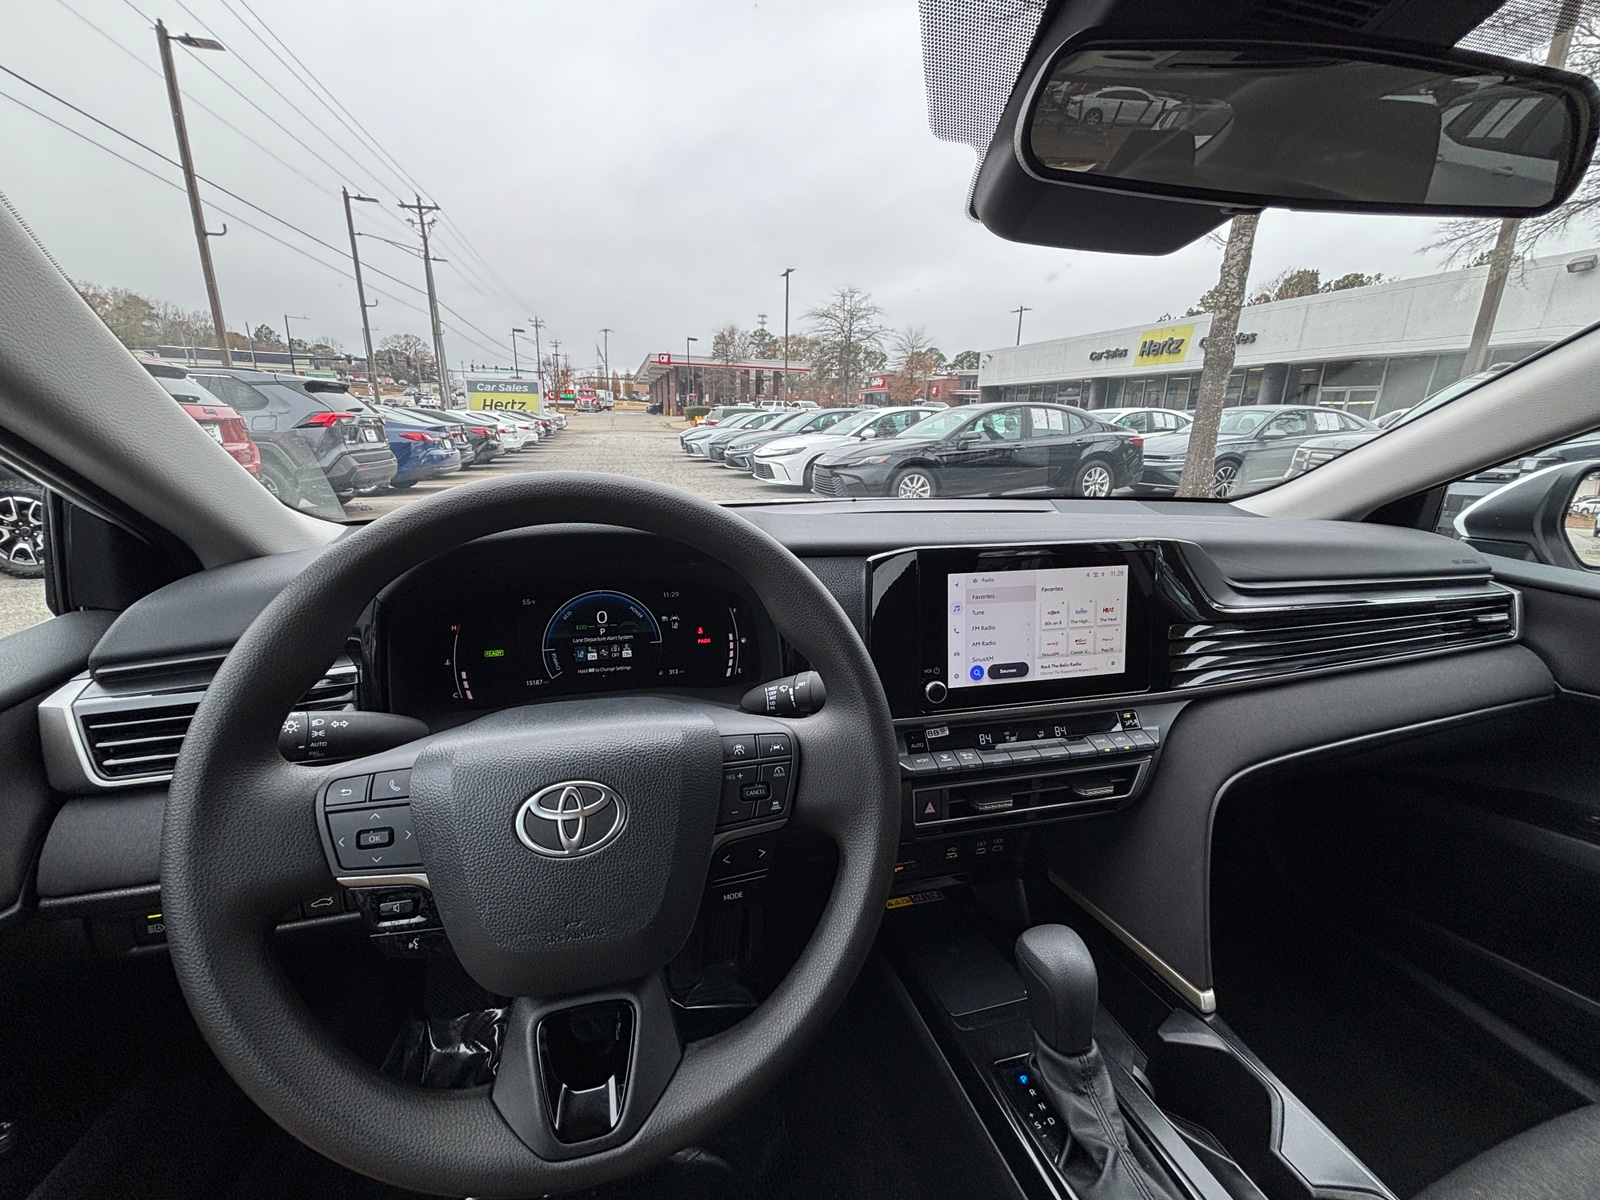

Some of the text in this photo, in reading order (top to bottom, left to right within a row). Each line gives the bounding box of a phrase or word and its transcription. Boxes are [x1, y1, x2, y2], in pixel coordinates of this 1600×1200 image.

[1138, 337, 1185, 356] Hertz
[1089, 348, 1128, 361] Car Sales
[476, 382, 528, 392] Car Sales
[482, 398, 527, 410] Hertz
[629, 606, 644, 618] POWER
[1054, 726, 1067, 738] 84
[978, 734, 992, 745] 84
[746, 788, 766, 796] CANCEL
[368, 834, 381, 842] OK
[723, 891, 744, 901] MODE
[1020, 1075, 1027, 1084] P
[1028, 1088, 1037, 1096] R
[1047, 1116, 1056, 1126] D
